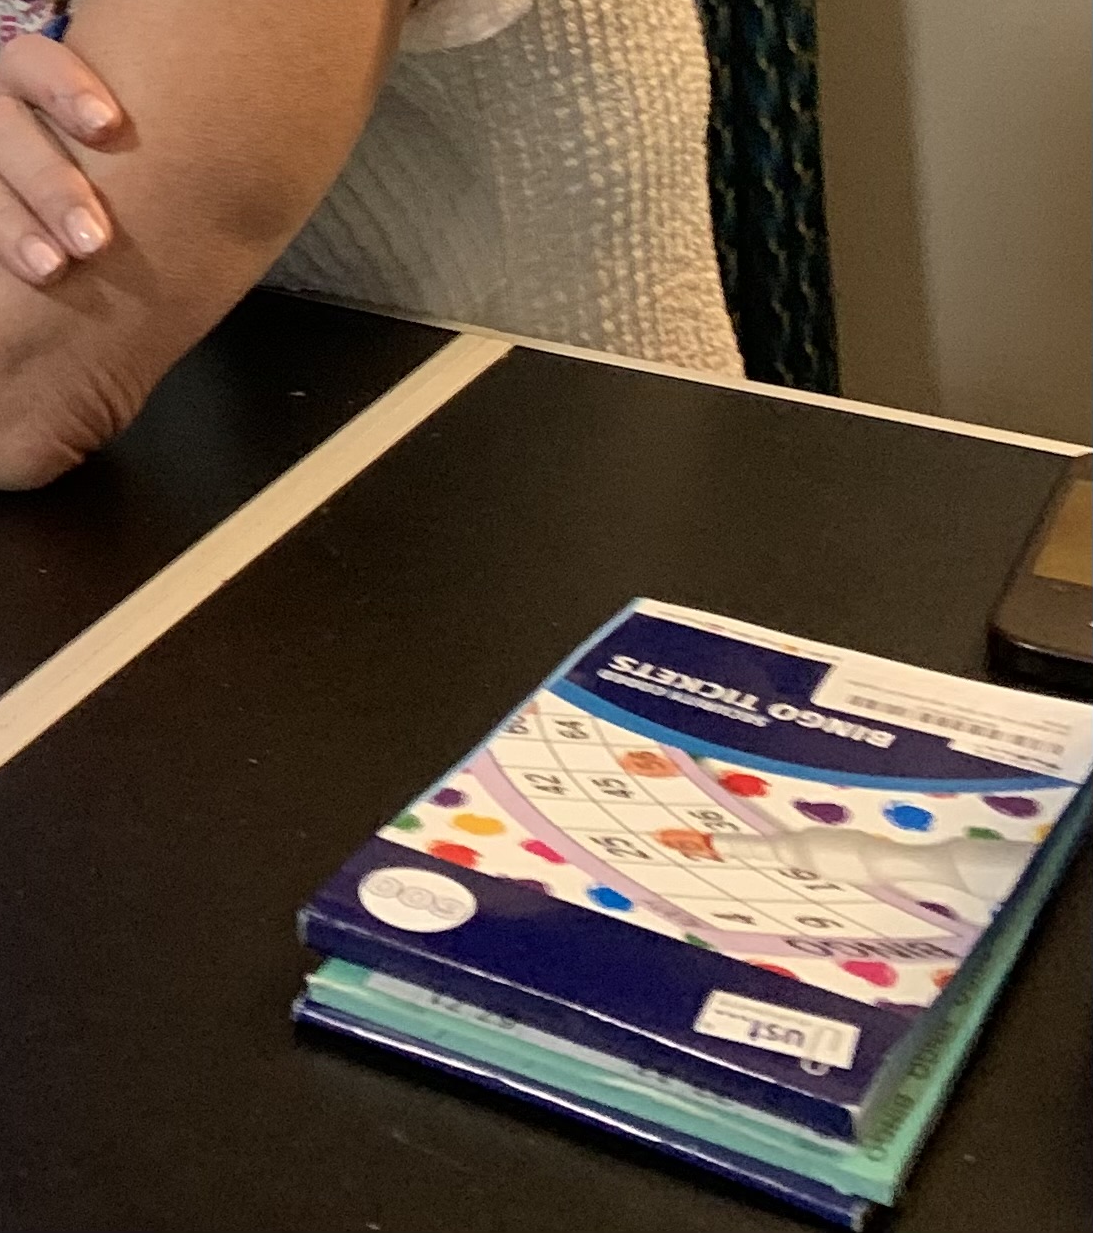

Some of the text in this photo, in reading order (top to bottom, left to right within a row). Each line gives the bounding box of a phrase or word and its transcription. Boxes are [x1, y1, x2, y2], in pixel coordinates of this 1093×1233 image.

[608, 654, 760, 711] TICKETS
[766, 703, 896, 748] BINGO
[524, 773, 568, 796] 42
[588, 777, 634, 799] 45
[589, 836, 650, 860] 25
[779, 936, 957, 960] BINGO
